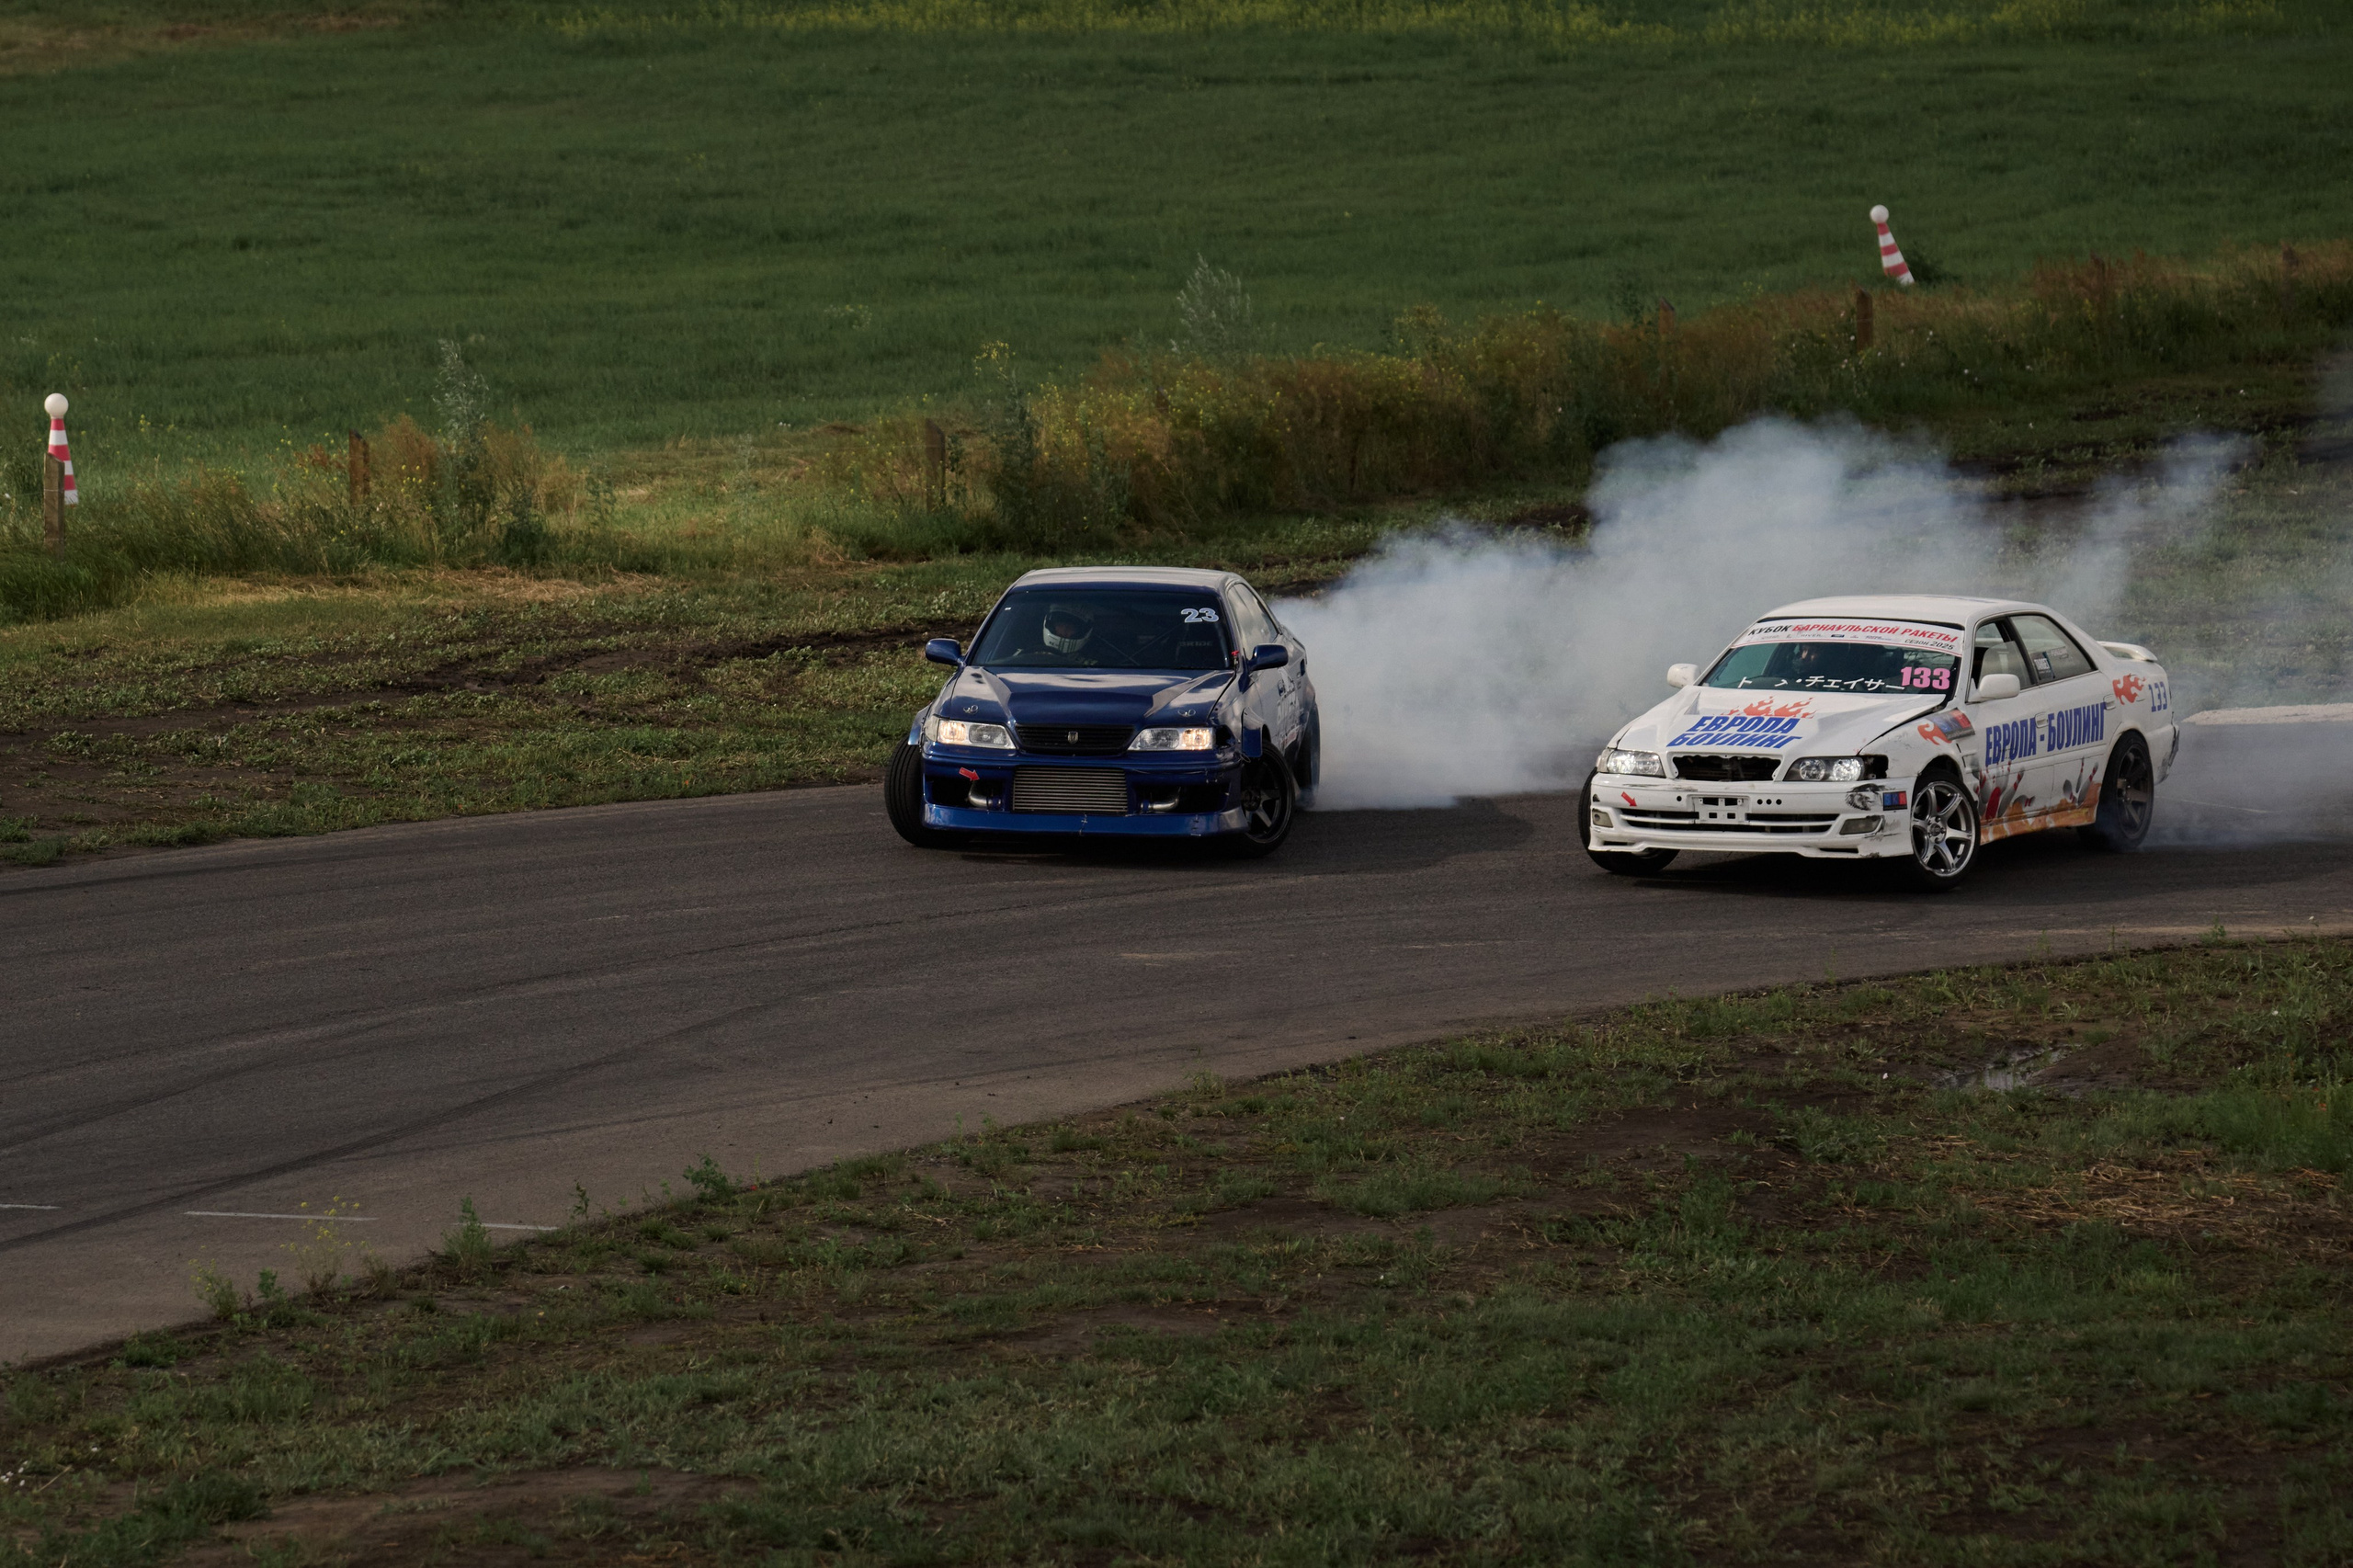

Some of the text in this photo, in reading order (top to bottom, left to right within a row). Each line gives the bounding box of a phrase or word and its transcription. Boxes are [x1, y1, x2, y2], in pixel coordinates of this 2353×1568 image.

[1181, 608, 1220, 623] 23
[1748, 625, 1791, 636] КУБОК
[1792, 624, 1900, 634] БАРНАУЛЬСКОЙ
[1901, 628, 1959, 642] РАКЕТЫ
[1930, 641, 1955, 651] 2025
[1900, 666, 1951, 690] 133
[2148, 681, 2168, 712] 133
[1686, 715, 1801, 734] ЕВРОПА
[1665, 733, 1802, 748] БОУЛИНГ
[1985, 717, 2037, 767] ЕВРОПА
[2047, 701, 2108, 752] БОУЛИНГ
